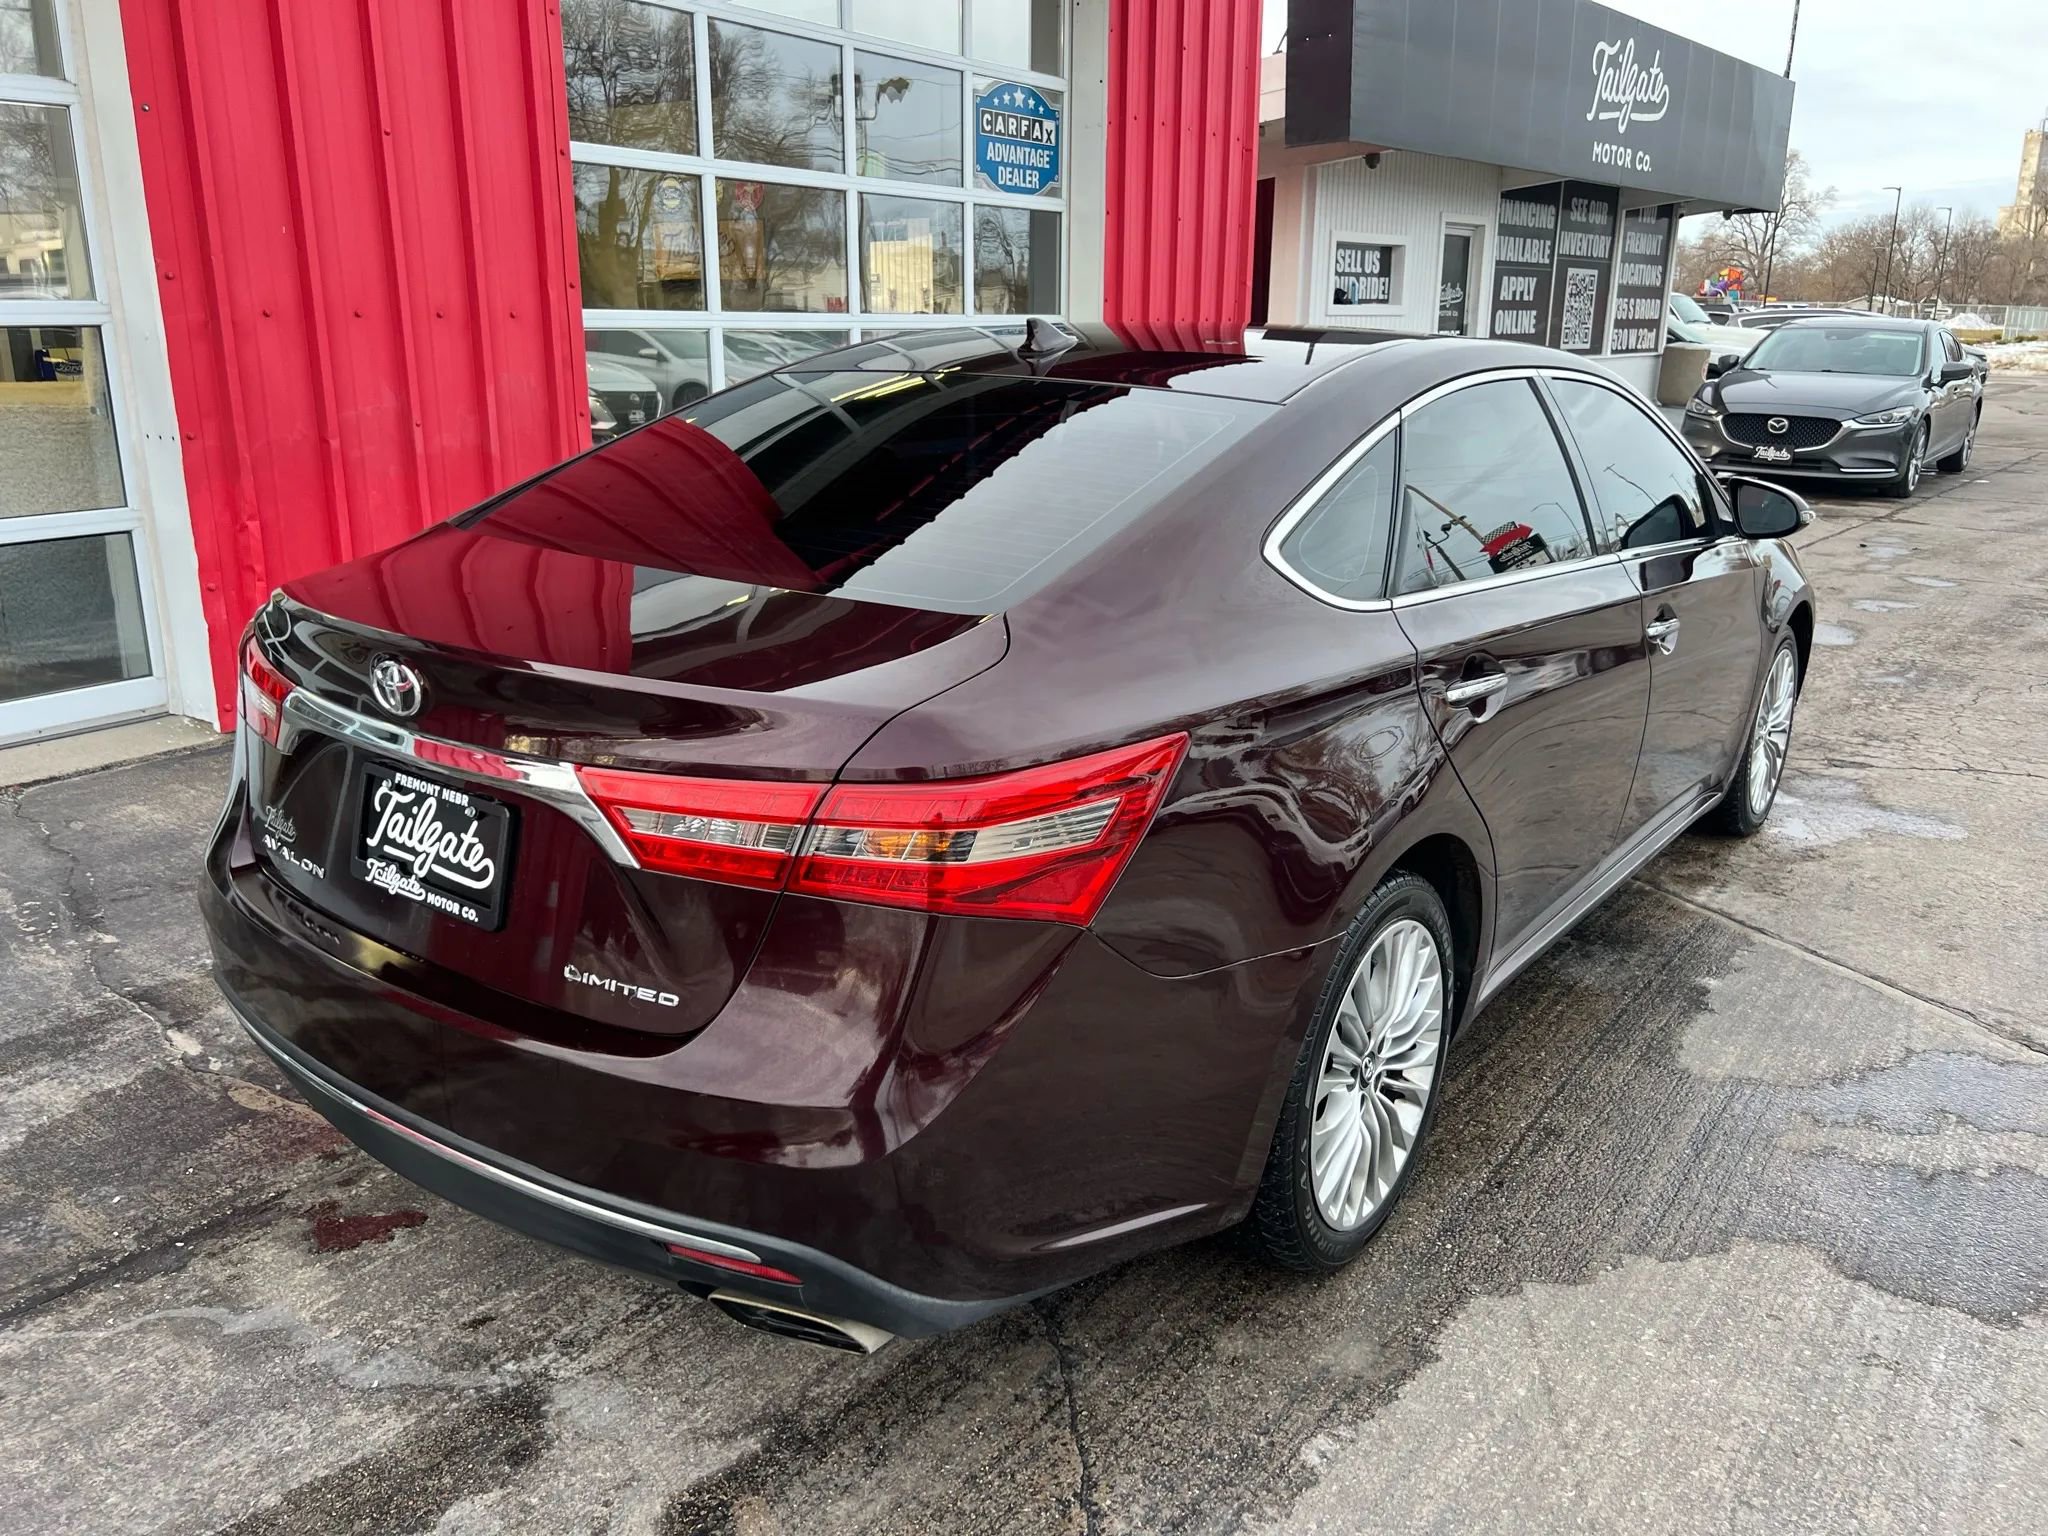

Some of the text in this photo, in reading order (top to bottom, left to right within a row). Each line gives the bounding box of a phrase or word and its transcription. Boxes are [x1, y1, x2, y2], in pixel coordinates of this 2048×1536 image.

[1586, 37, 1669, 134] Tailgate
[982, 112, 1054, 145] CARFAX
[986, 141, 1051, 169] ADVANTAGE
[1592, 141, 1632, 169] MOTOR
[998, 165, 1040, 189] DEALER
[1499, 198, 1556, 230] INANCING
[1569, 197, 1609, 225] SEE OUR
[1495, 235, 1552, 264] AVAILABLE
[1559, 231, 1613, 259] INVENTORY
[1624, 231, 1664, 257] FREMONT
[1336, 248, 1381, 275] SELL US
[1618, 262, 1663, 288] LOCATIONS
[1359, 276, 1390, 300] RIDE!
[1500, 275, 1537, 302] APPLY
[1494, 309, 1538, 335] ONLINE
[1612, 328, 1628, 351] 520
[1628, 328, 1638, 350] W
[1753, 446, 1791, 462] Tailgate
[395, 772, 470, 807] FREMONT NEBR
[264, 805, 297, 843] Tailgate
[366, 786, 495, 890] Tailgate
[262, 834, 325, 879] AVALON
[365, 858, 479, 922] Tailgate MOTOR CO.
[563, 964, 680, 1007] LIMITED
